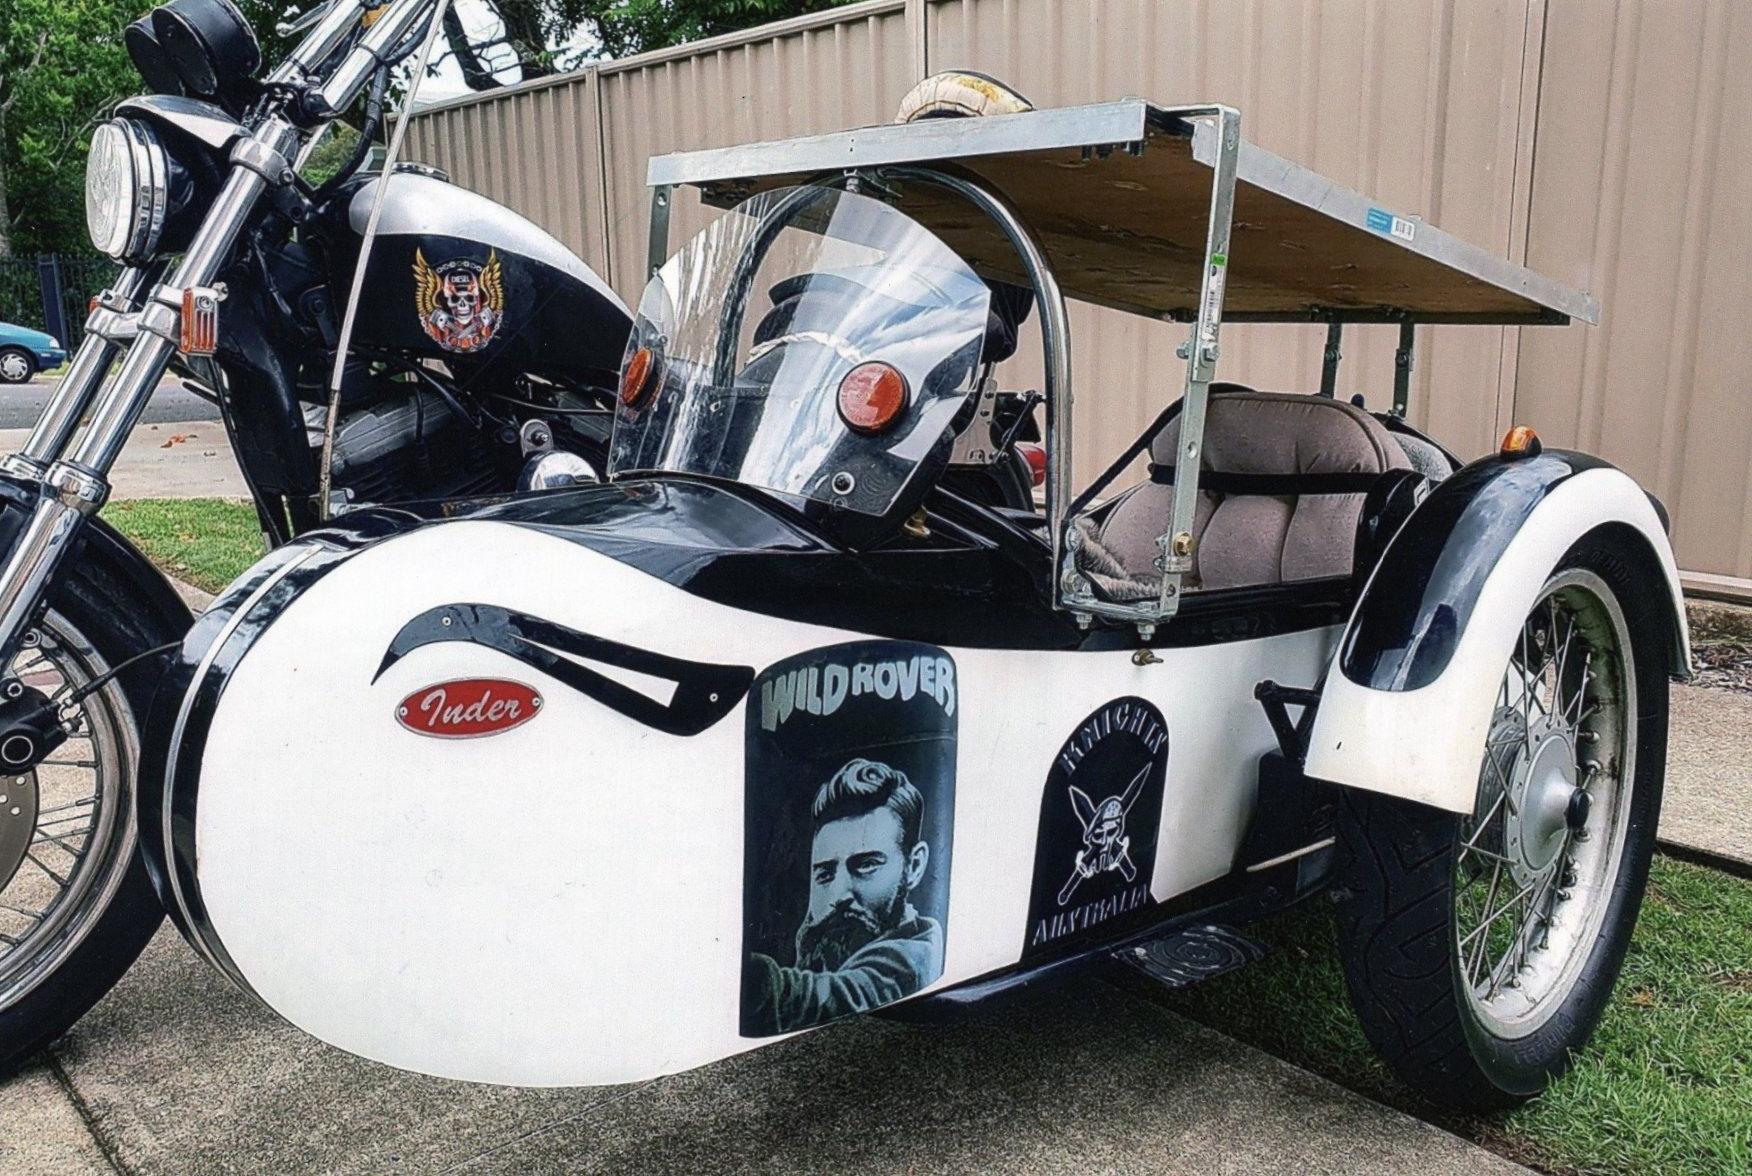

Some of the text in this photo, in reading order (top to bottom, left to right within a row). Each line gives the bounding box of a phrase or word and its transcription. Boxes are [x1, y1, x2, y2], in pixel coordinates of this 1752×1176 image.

[420, 688, 522, 726] Inder
[761, 656, 955, 732] WILD ROVER
[1058, 703, 1168, 776] KNIGHTS
[1032, 883, 1147, 946] AUSTRALIA
